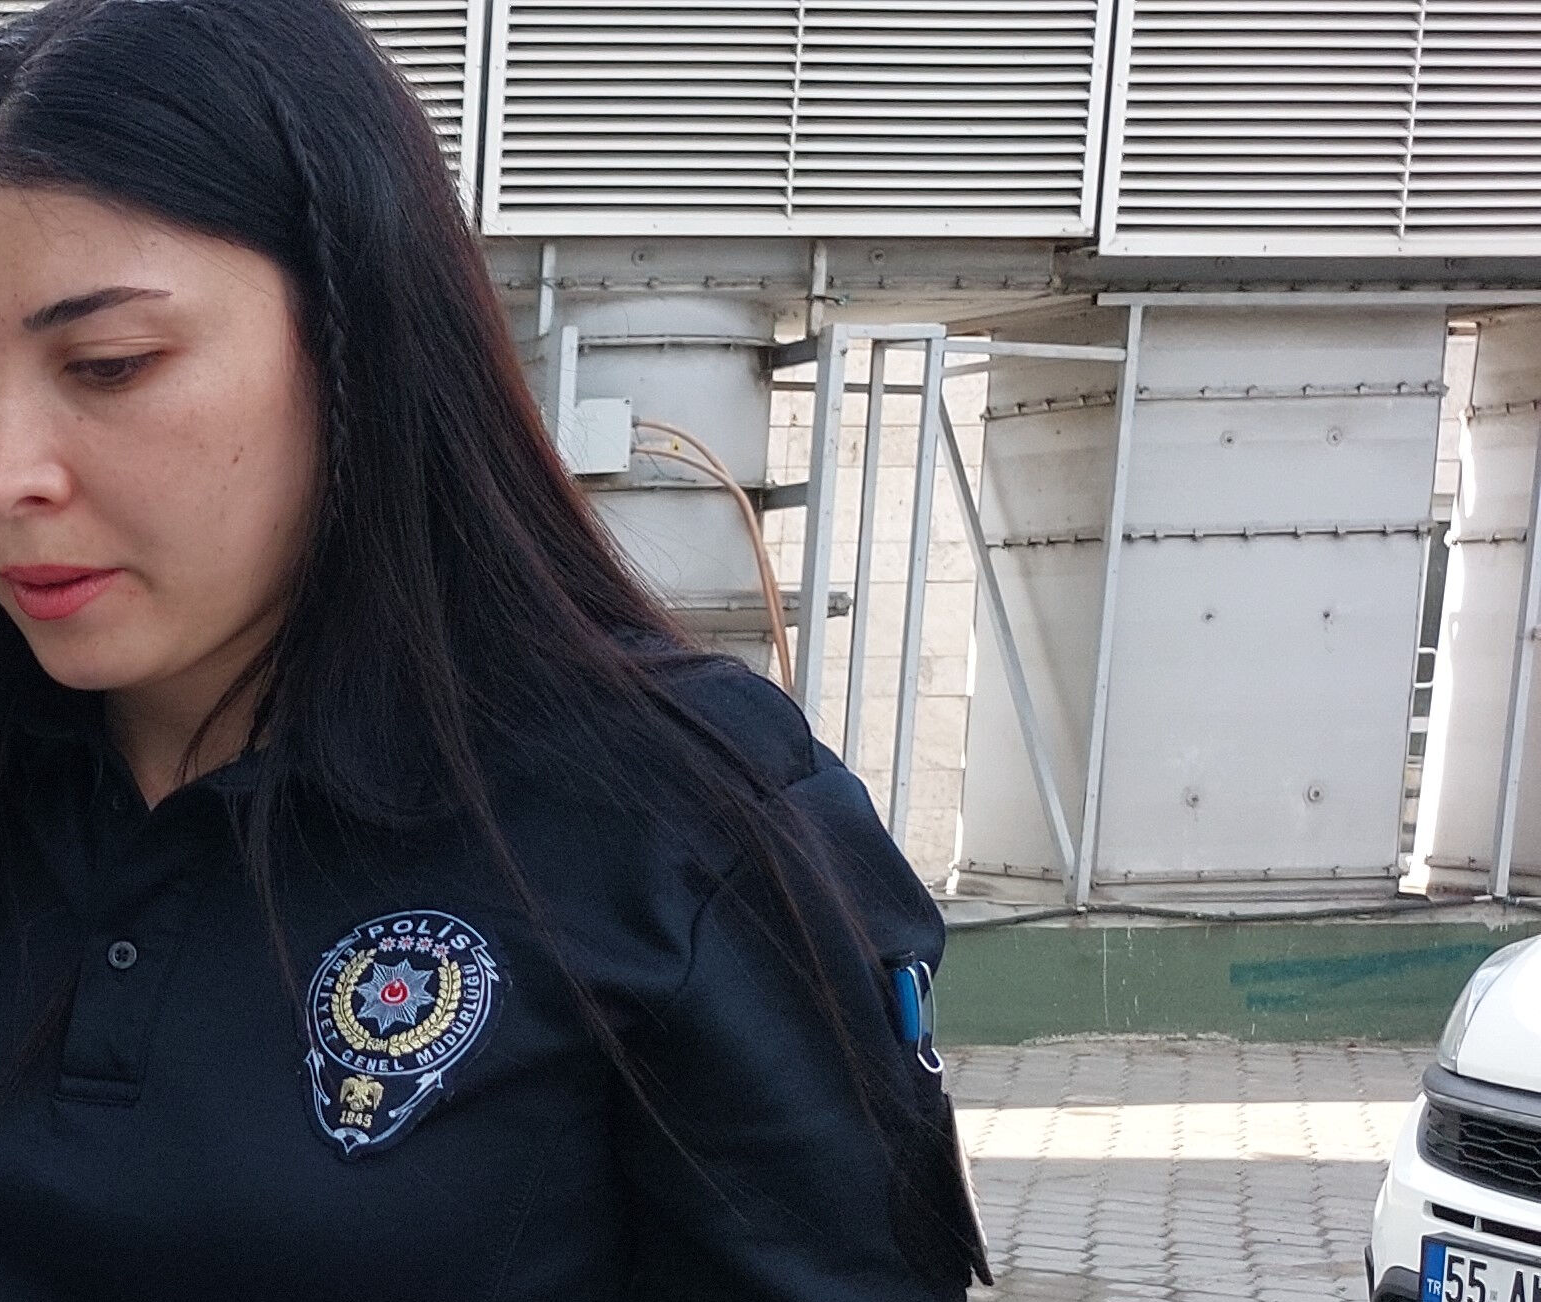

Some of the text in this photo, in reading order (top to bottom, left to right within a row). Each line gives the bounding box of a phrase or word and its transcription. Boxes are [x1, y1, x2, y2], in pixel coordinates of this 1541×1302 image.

[367, 918, 471, 951] POLİS
[316, 946, 480, 1072] EMNİYET GENEL MÜDÜRLÜĞÜ
[339, 1110, 373, 1128] 1845
[1427, 1278, 1442, 1296] TR
